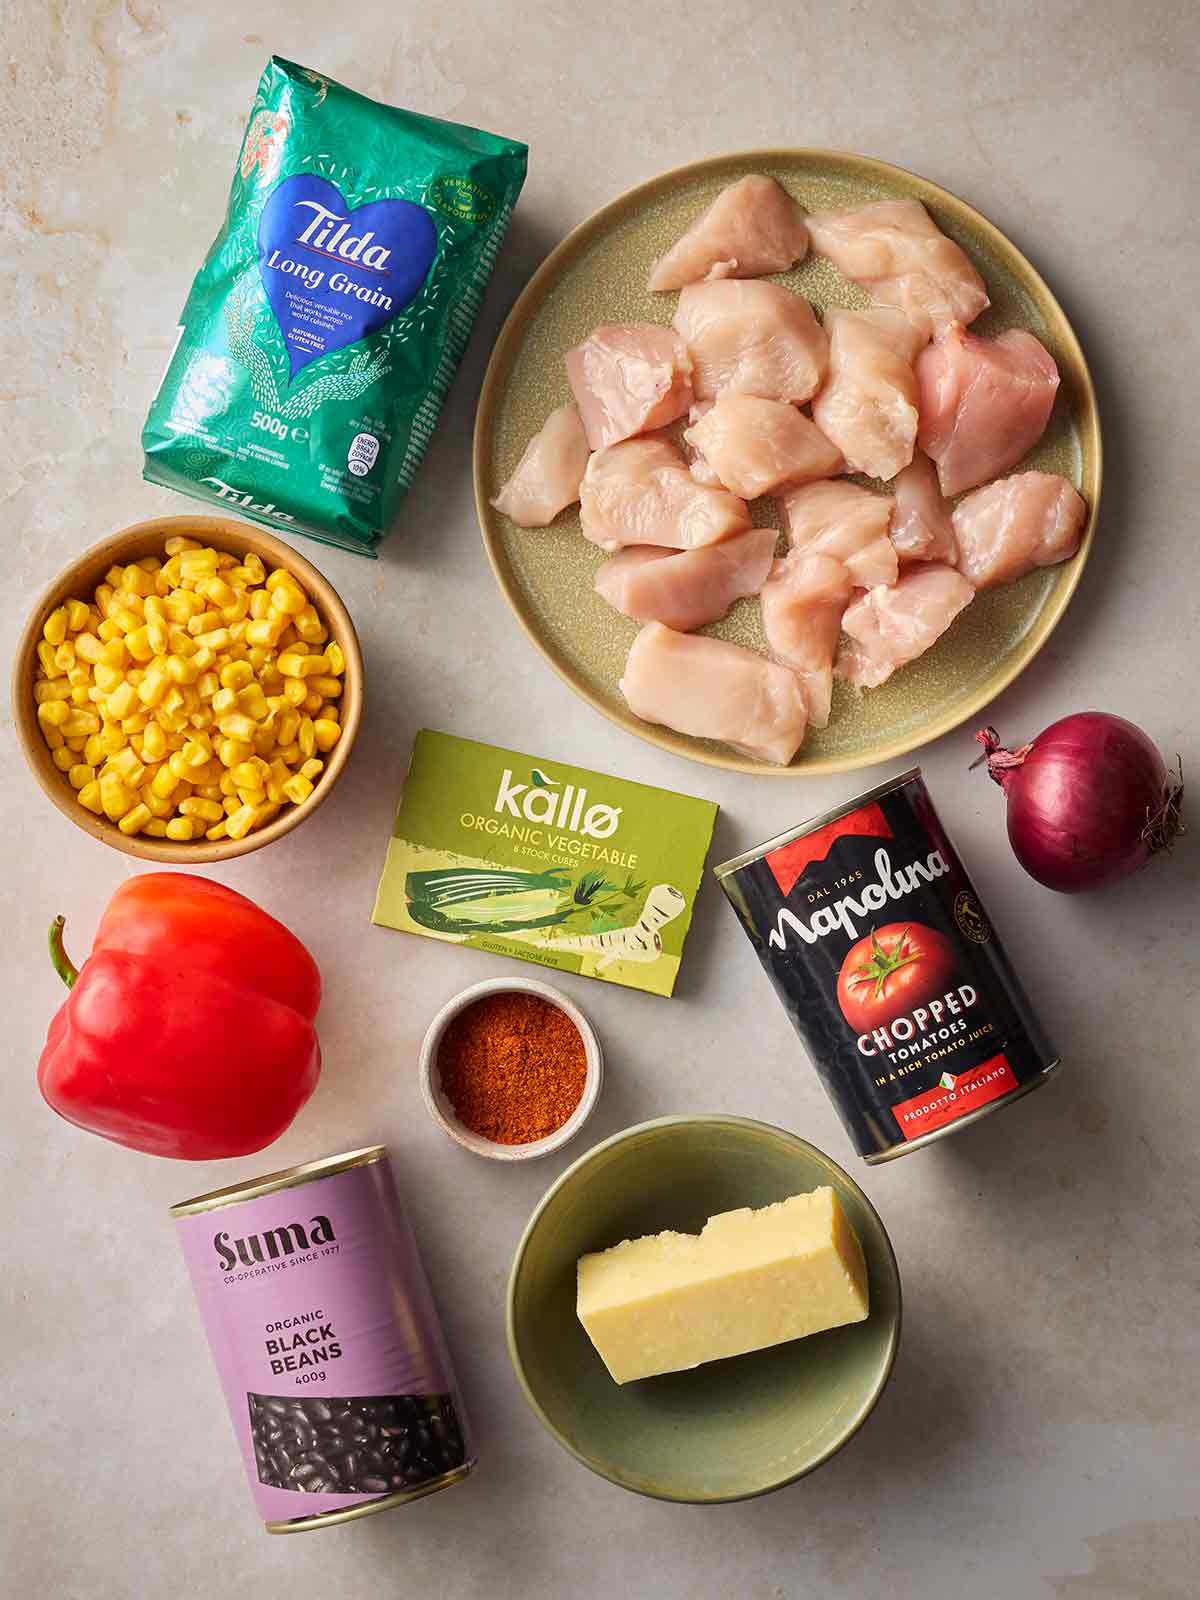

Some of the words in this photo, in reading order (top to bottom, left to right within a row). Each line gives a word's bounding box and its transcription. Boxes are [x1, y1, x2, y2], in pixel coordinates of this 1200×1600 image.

[293, 201, 392, 271] Tilda
[267, 250, 325, 289] Long
[329, 273, 393, 311] Grain
[285, 291, 313, 306] Delicious
[290, 301, 303, 311] that
[304, 308, 322, 317] works
[323, 315, 344, 325] across
[291, 311, 310, 321] world
[287, 332, 310, 345] GLUTEN
[310, 340, 326, 350] FREE
[292, 327, 325, 343] NATURALLY
[251, 411, 288, 440] 500g
[357, 436, 377, 449] ENERGY
[199, 477, 295, 522] Tilda
[460, 812, 543, 845] ORGANIC
[547, 833, 638, 869] VEGETABLE
[521, 846, 549, 861] STOCK
[551, 855, 580, 867] CUBES
[768, 848, 950, 950] Napolina
[807, 887, 831, 903] DAL
[834, 871, 863, 889] 1965
[857, 984, 977, 1056] CHOPPED
[875, 1076, 886, 1087] IN
[889, 1073, 896, 1081] A
[897, 1060, 923, 1077] RICH
[924, 1038, 966, 1063] TOMATO
[968, 1023, 993, 1042] JUICE
[888, 1018, 967, 1064] TOMATOES
[903, 1093, 957, 1122] PRODOTTO
[960, 1067, 1006, 1096] ITALIANO
[213, 1215, 336, 1272] Suma
[223, 1260, 287, 1285] CO-OPERATIVE
[290, 1251, 319, 1267] SINCE
[320, 1245, 340, 1257] 1977
[265, 1310, 324, 1333] ORGANIC
[265, 1323, 337, 1356] BLACK
[270, 1342, 342, 1375] BEANS
[295, 1371, 327, 1385] 400g
